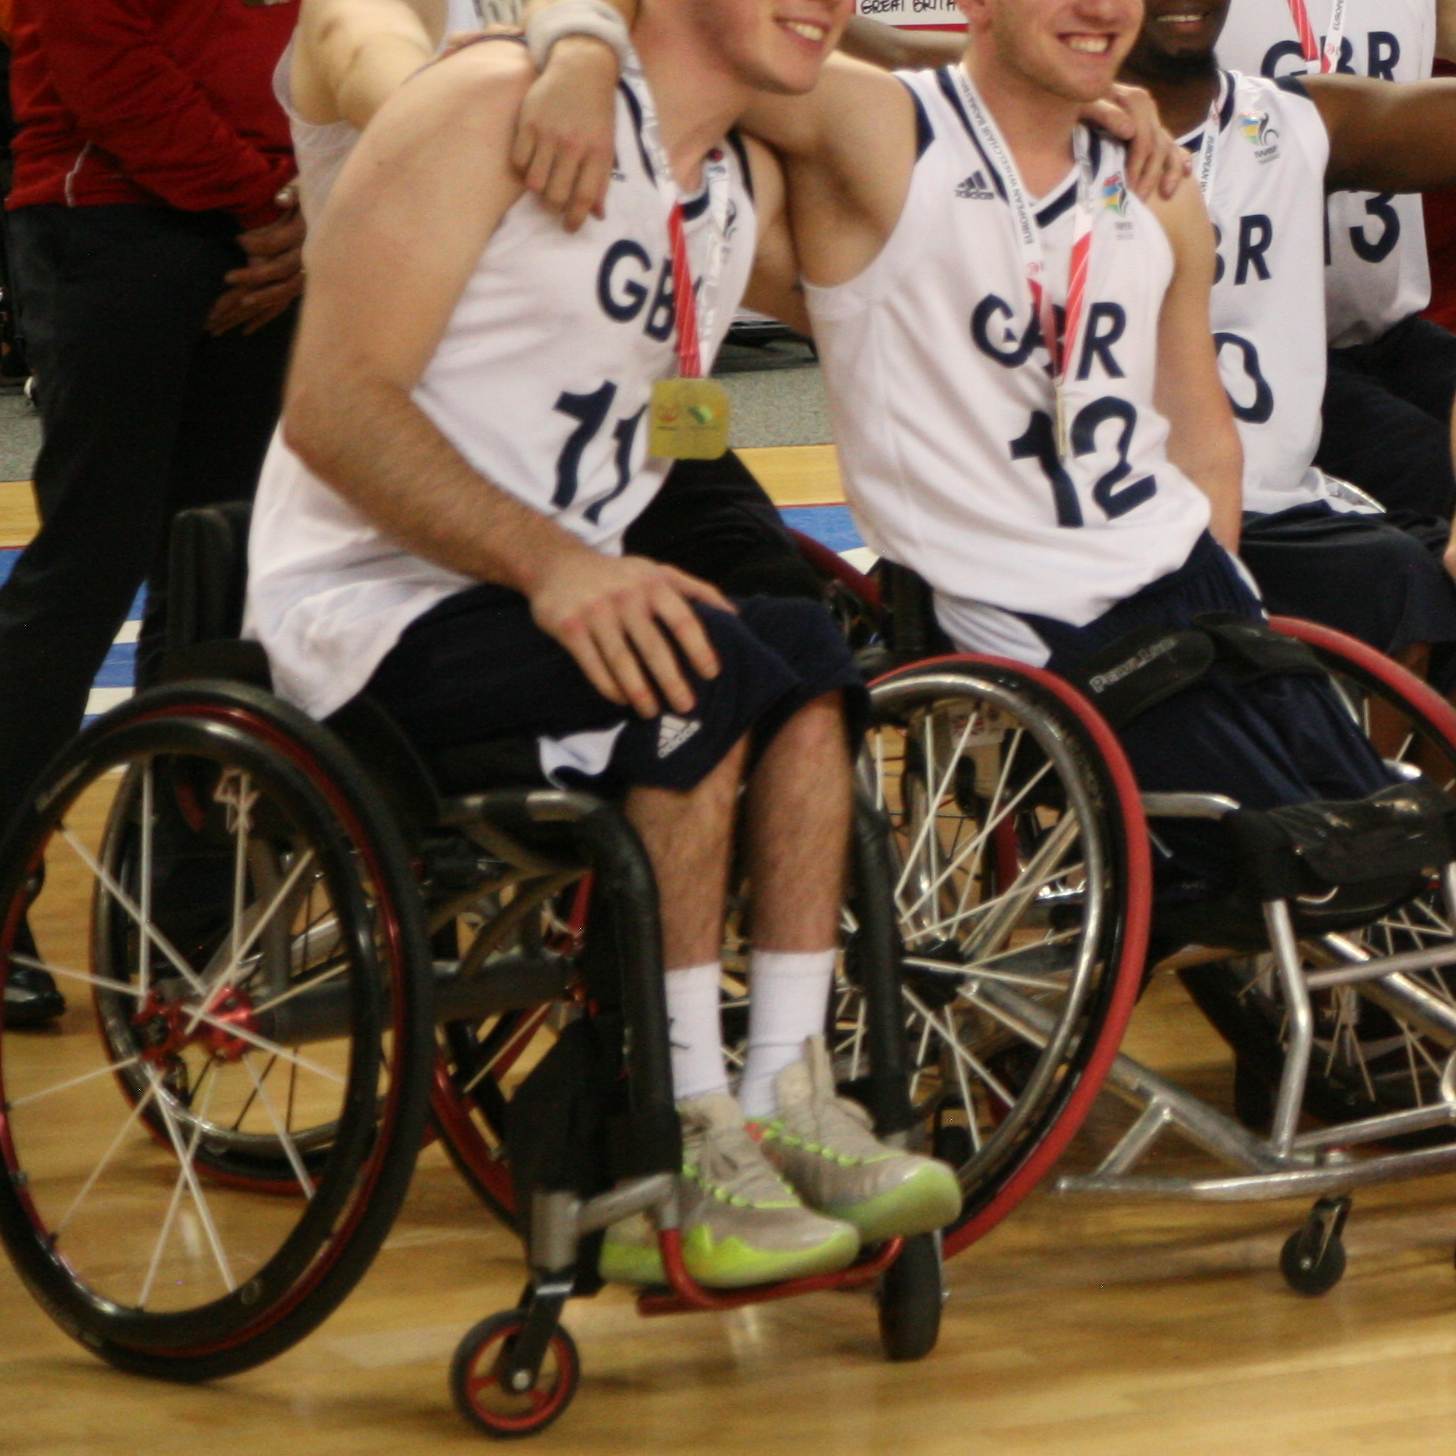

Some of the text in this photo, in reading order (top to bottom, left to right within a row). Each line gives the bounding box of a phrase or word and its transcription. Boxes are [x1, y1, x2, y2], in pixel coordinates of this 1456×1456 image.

[1260, 30, 1401, 81] GBR
[1009, 187, 1035, 245] EUROPEAN
[1212, 214, 1273, 286] BR
[596, 239, 702, 343] GB
[551, 380, 649, 526] 11
[1009, 394, 1158, 529] 12
